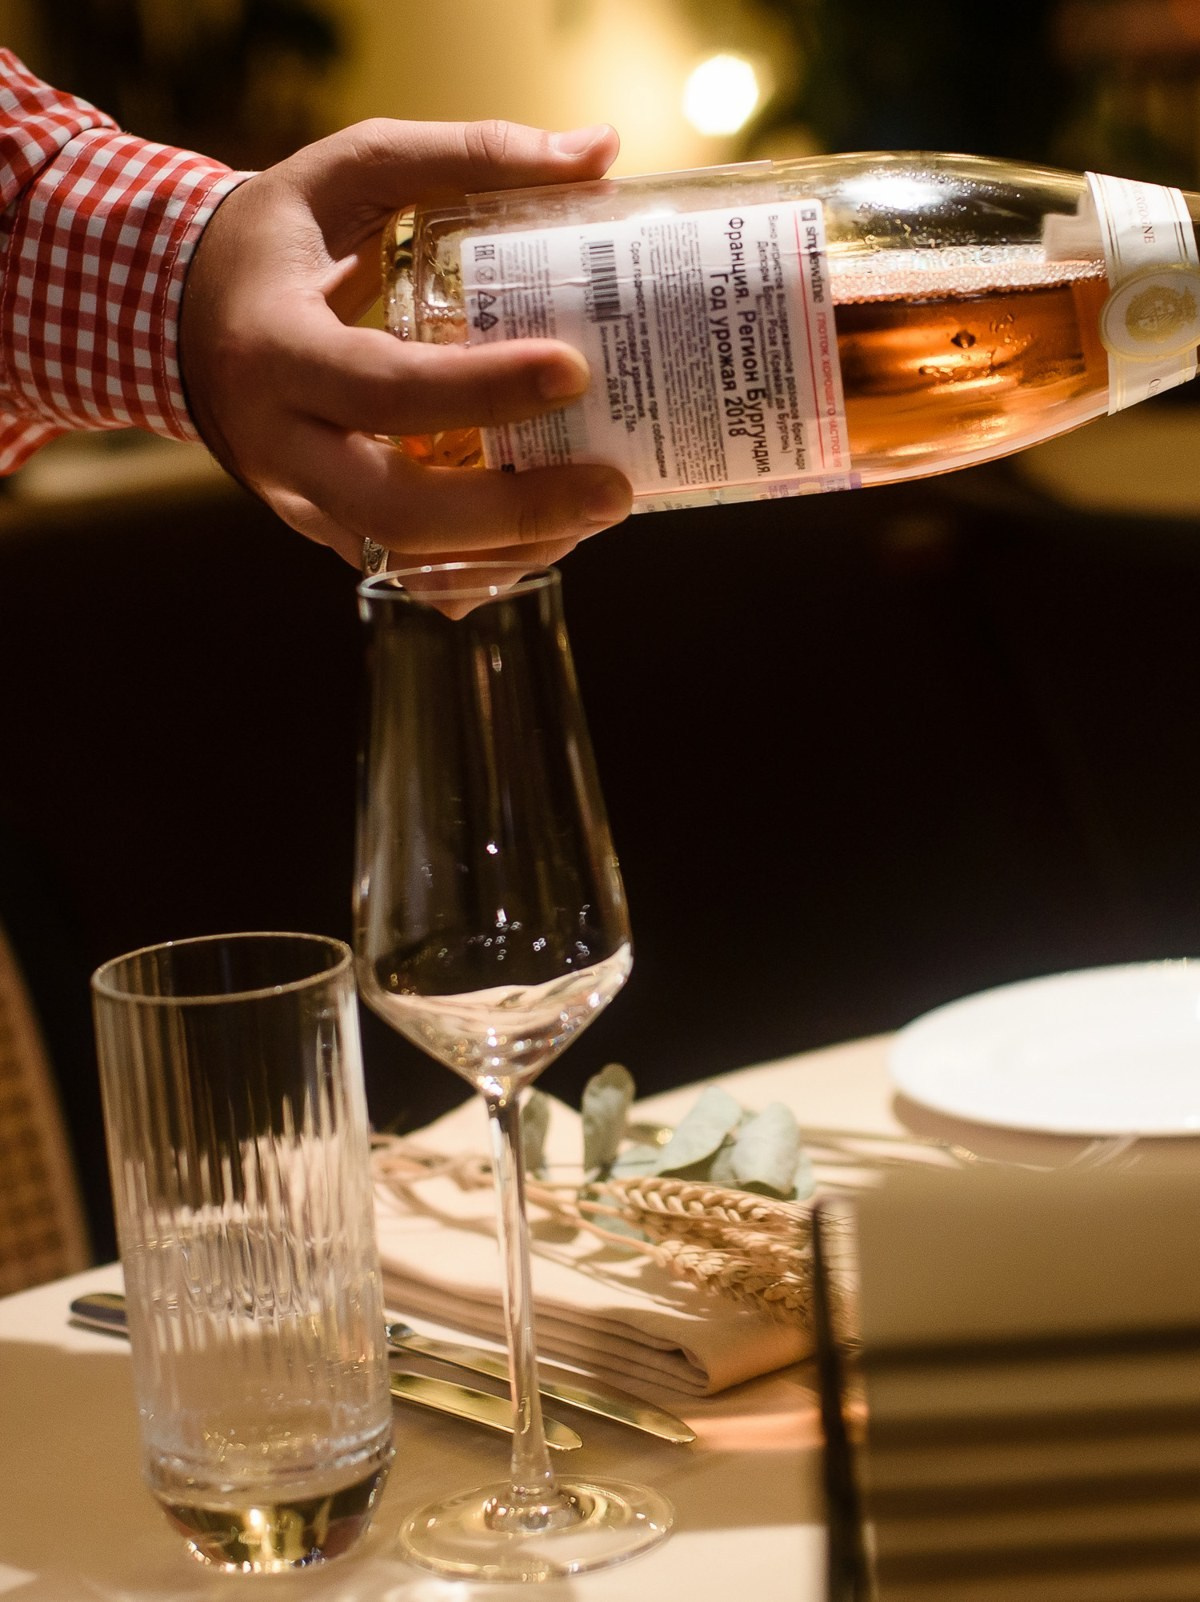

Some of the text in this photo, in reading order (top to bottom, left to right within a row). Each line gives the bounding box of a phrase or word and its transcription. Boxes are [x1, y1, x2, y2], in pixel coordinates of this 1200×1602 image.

[628, 240, 642, 264] Срок
[724, 216, 749, 304] Франция.
[710, 273, 729, 311] Год
[709, 315, 737, 391] урожая
[738, 311, 759, 382] Регион
[768, 214, 779, 239] Вино
[791, 421, 805, 445] брют
[815, 312, 829, 357] ГЛОТОК
[724, 395, 746, 437] 2018
[821, 358, 836, 416] ХОРОШЕГО
[745, 387, 771, 477] Бургундия.
